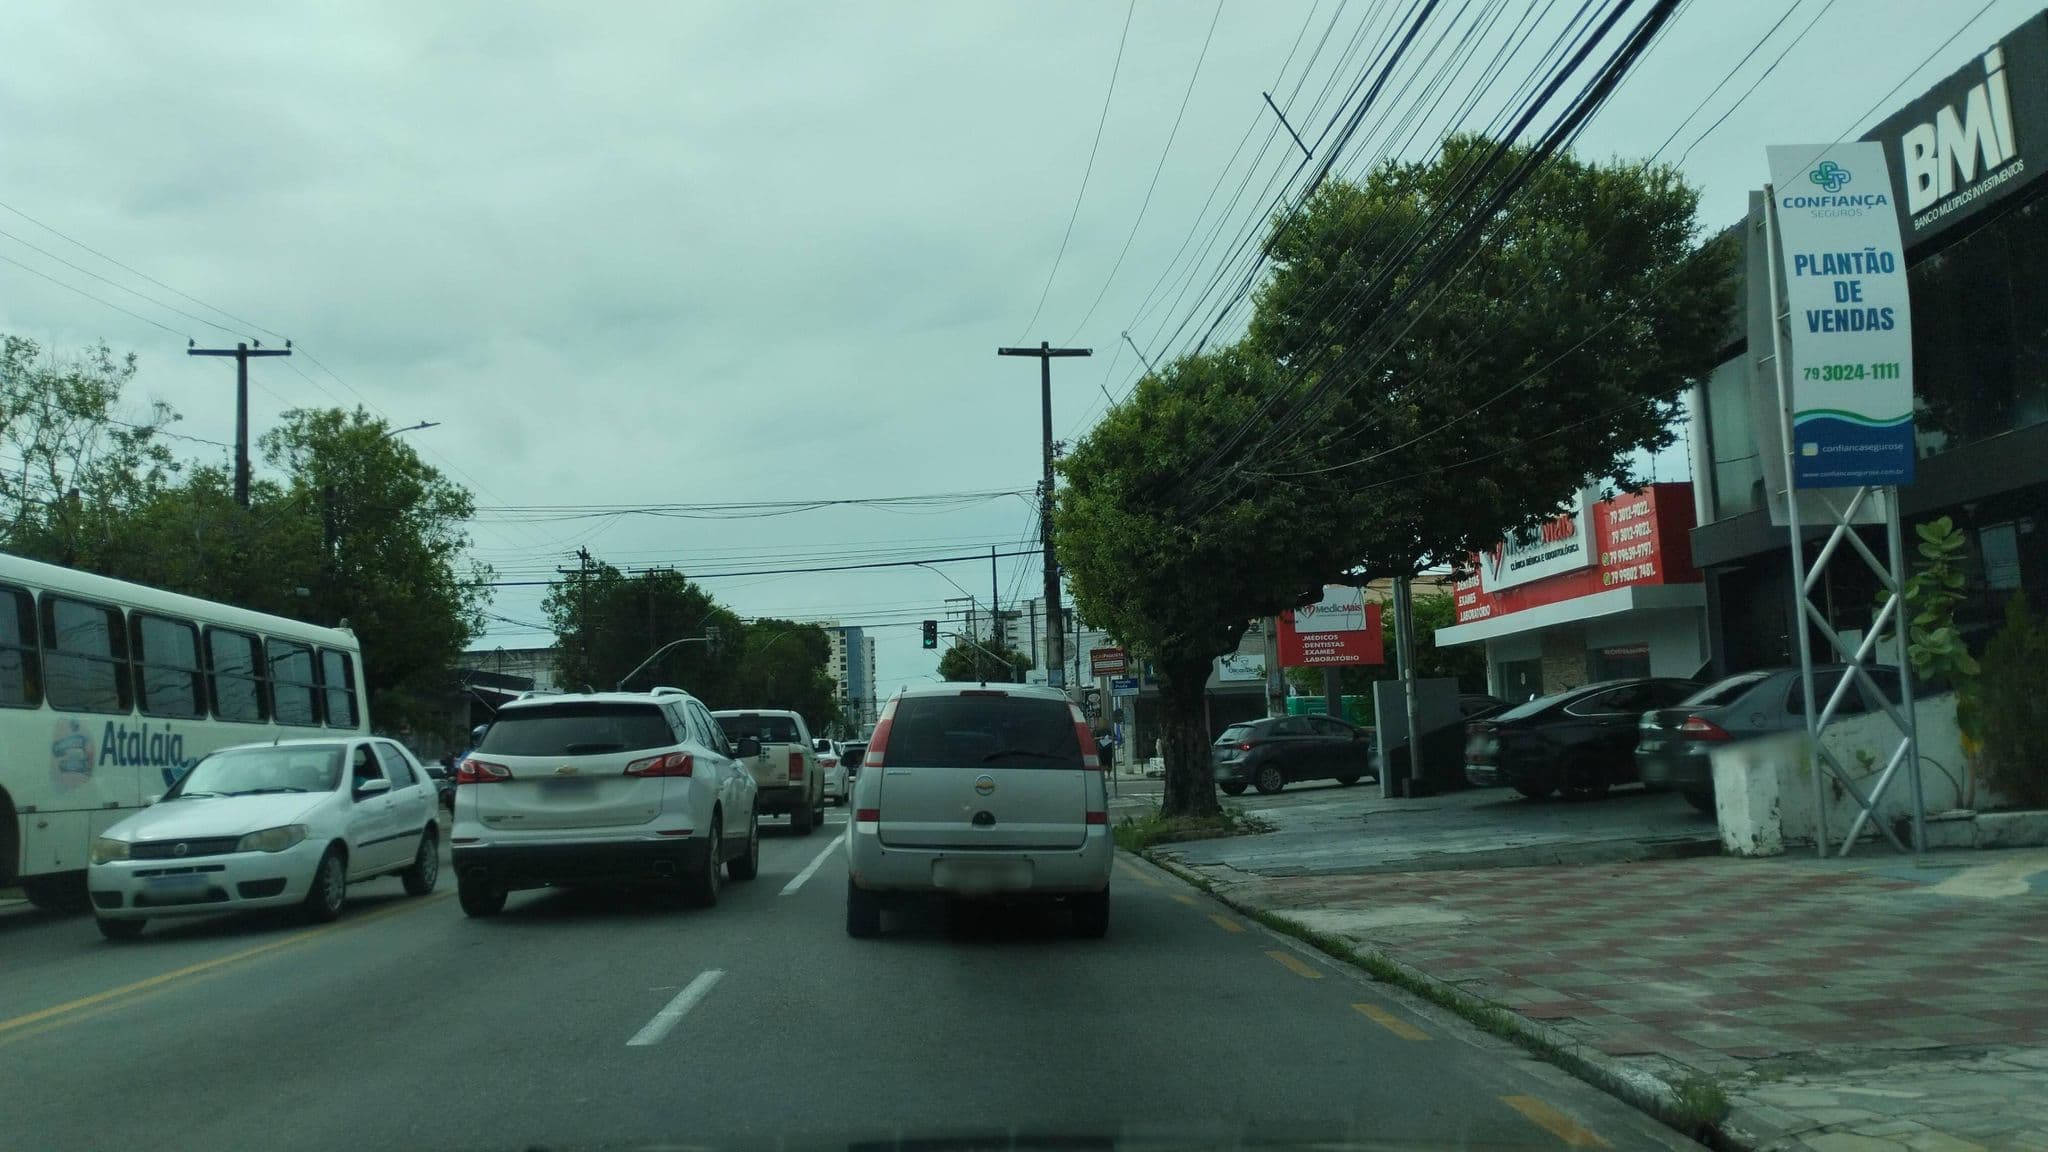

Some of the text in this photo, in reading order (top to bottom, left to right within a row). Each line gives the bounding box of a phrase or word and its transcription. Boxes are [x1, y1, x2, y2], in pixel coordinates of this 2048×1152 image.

[1783, 194, 1888, 210] CONFIANÇA
[1914, 208, 1939, 231] BANCO
[1973, 159, 2025, 199] INVESTIMENTOS
[1810, 208, 1863, 219] SEGUROS
[1794, 247, 1895, 276] PLANTÃO
[1834, 280, 1863, 303] DE
[1806, 307, 1895, 333] VENDAS
[1803, 362, 1900, 381] 79 3024-1111
[99, 720, 188, 768] Atalaia
